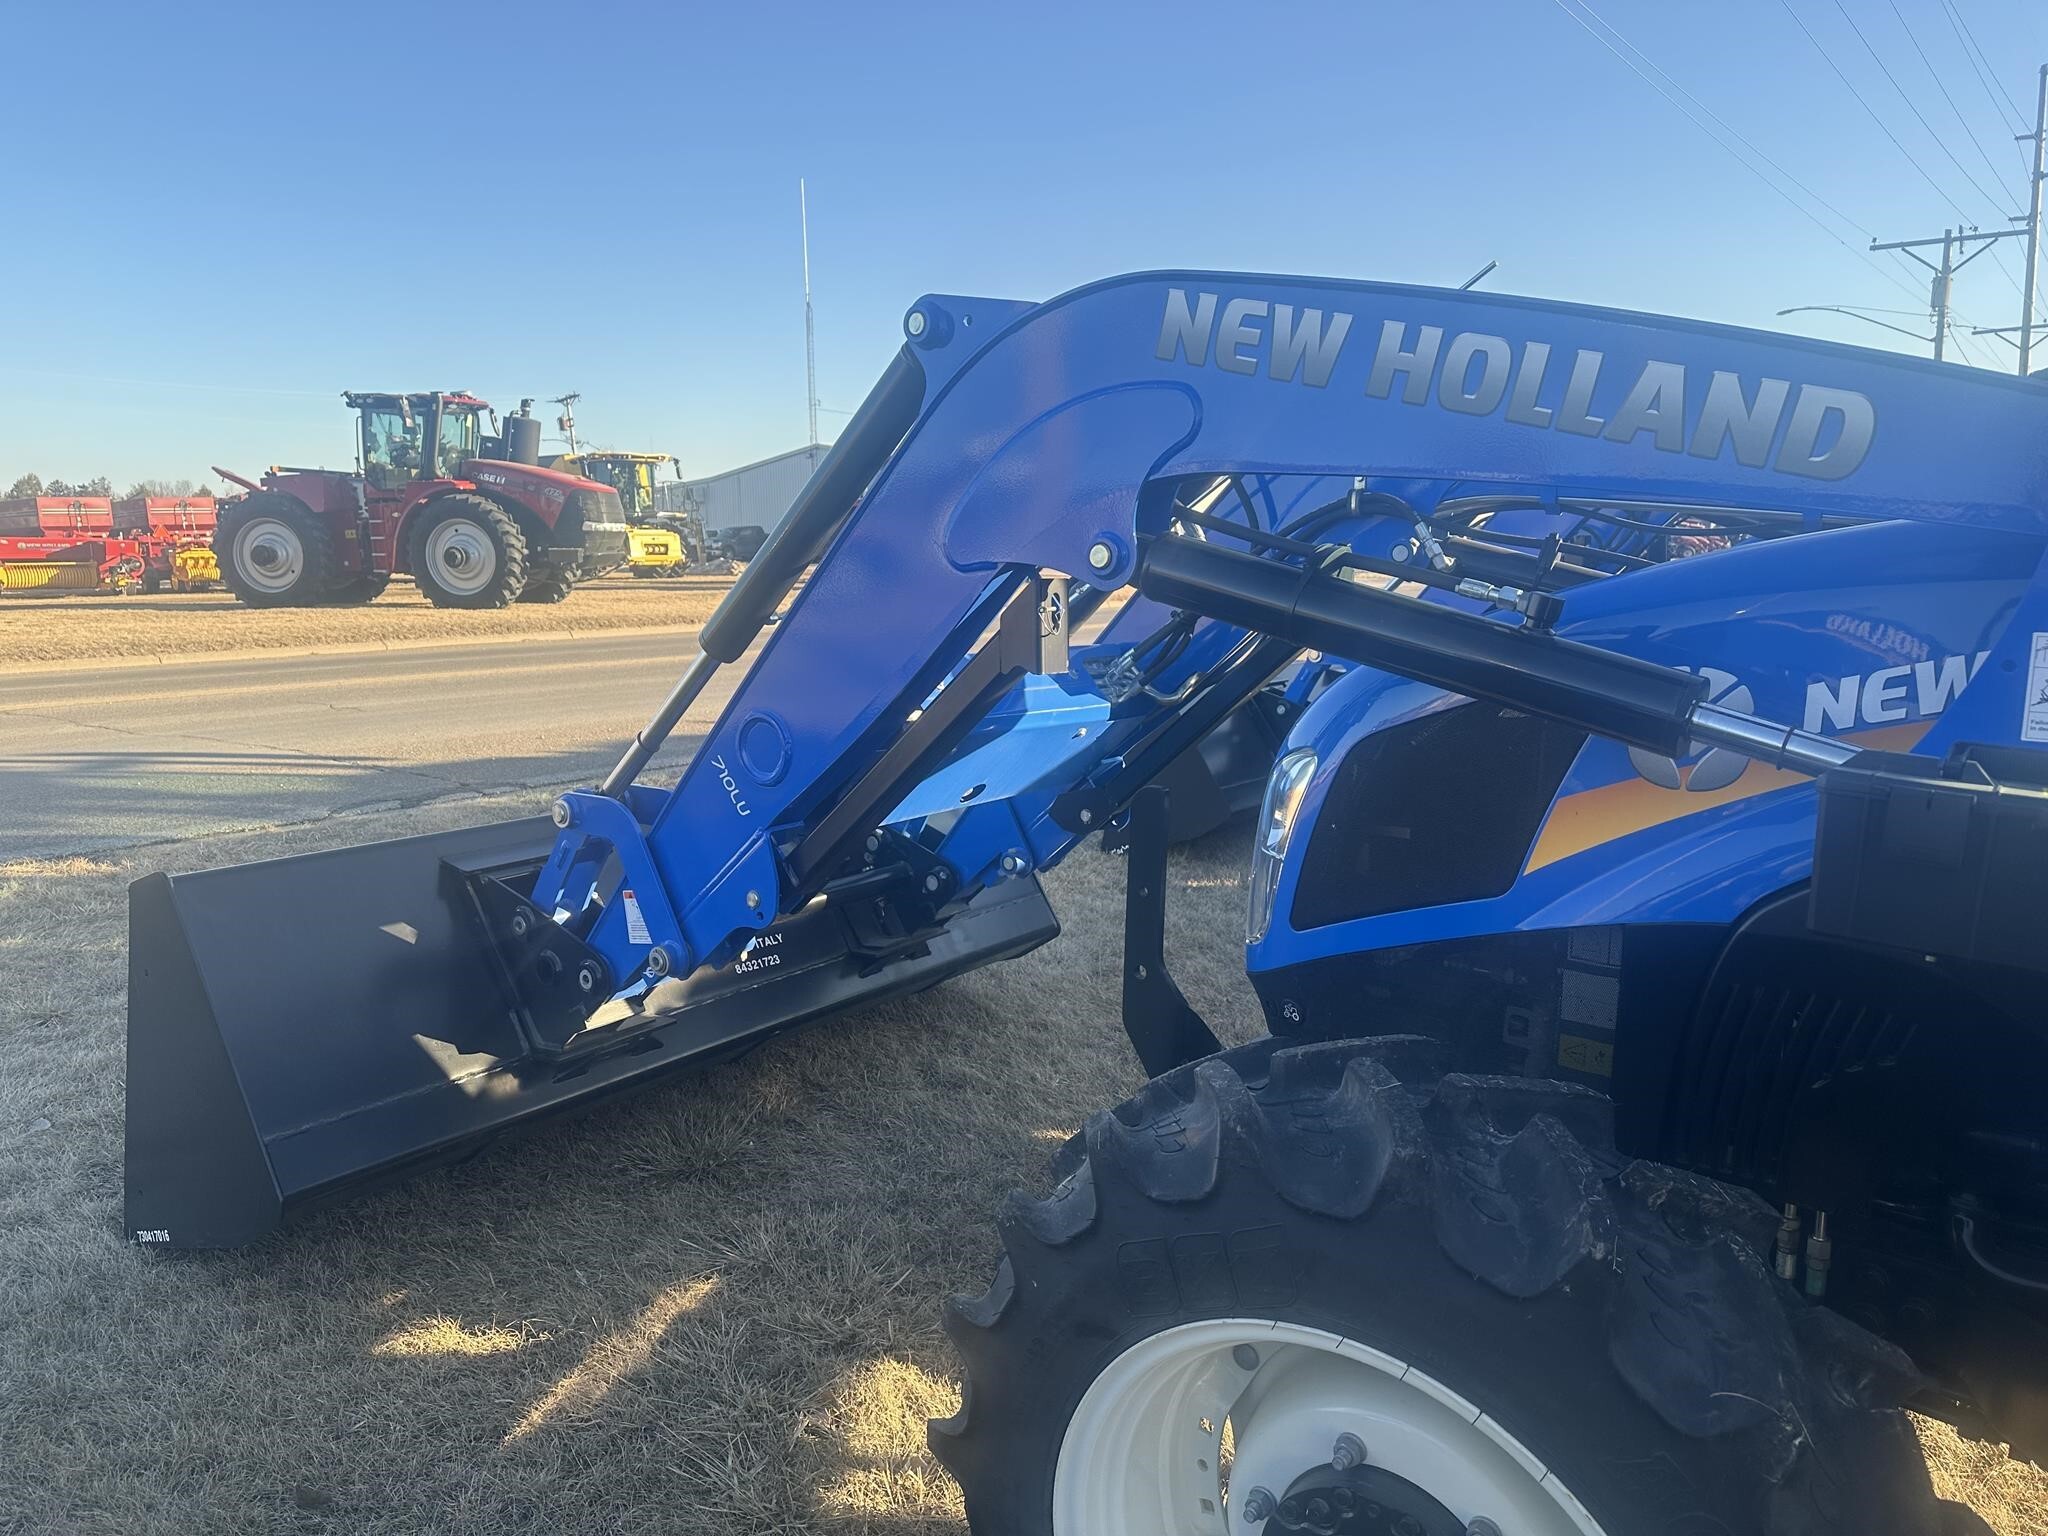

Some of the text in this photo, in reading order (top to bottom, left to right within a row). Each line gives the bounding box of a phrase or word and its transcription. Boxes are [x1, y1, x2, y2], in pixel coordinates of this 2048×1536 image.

[1154, 287, 1877, 482] NEW HOLLAND
[1802, 650, 1991, 734] NEW
[735, 954, 780, 974] 84321723
